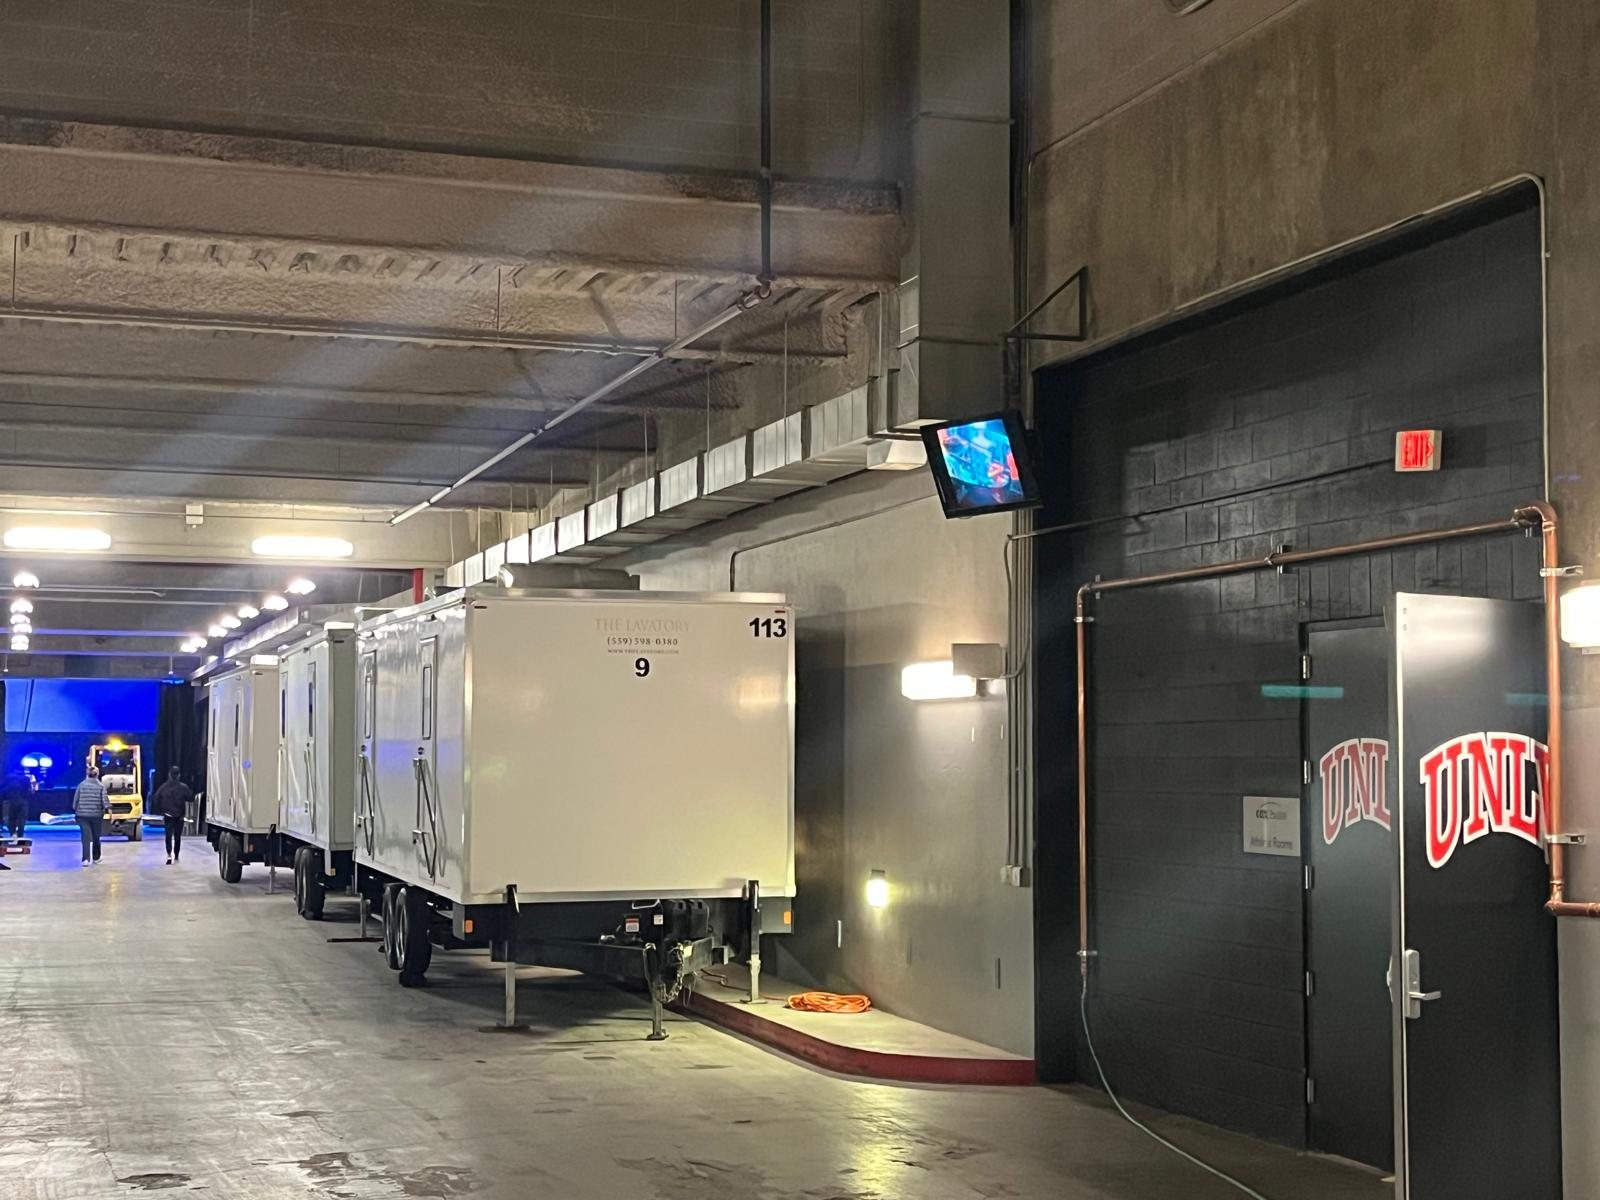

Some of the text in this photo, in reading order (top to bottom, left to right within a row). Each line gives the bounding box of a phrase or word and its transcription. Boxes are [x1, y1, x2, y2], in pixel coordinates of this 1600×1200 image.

[594, 618, 689, 632] THE LAVATORY
[749, 617, 787, 638] 113
[635, 657, 650, 677] 9
